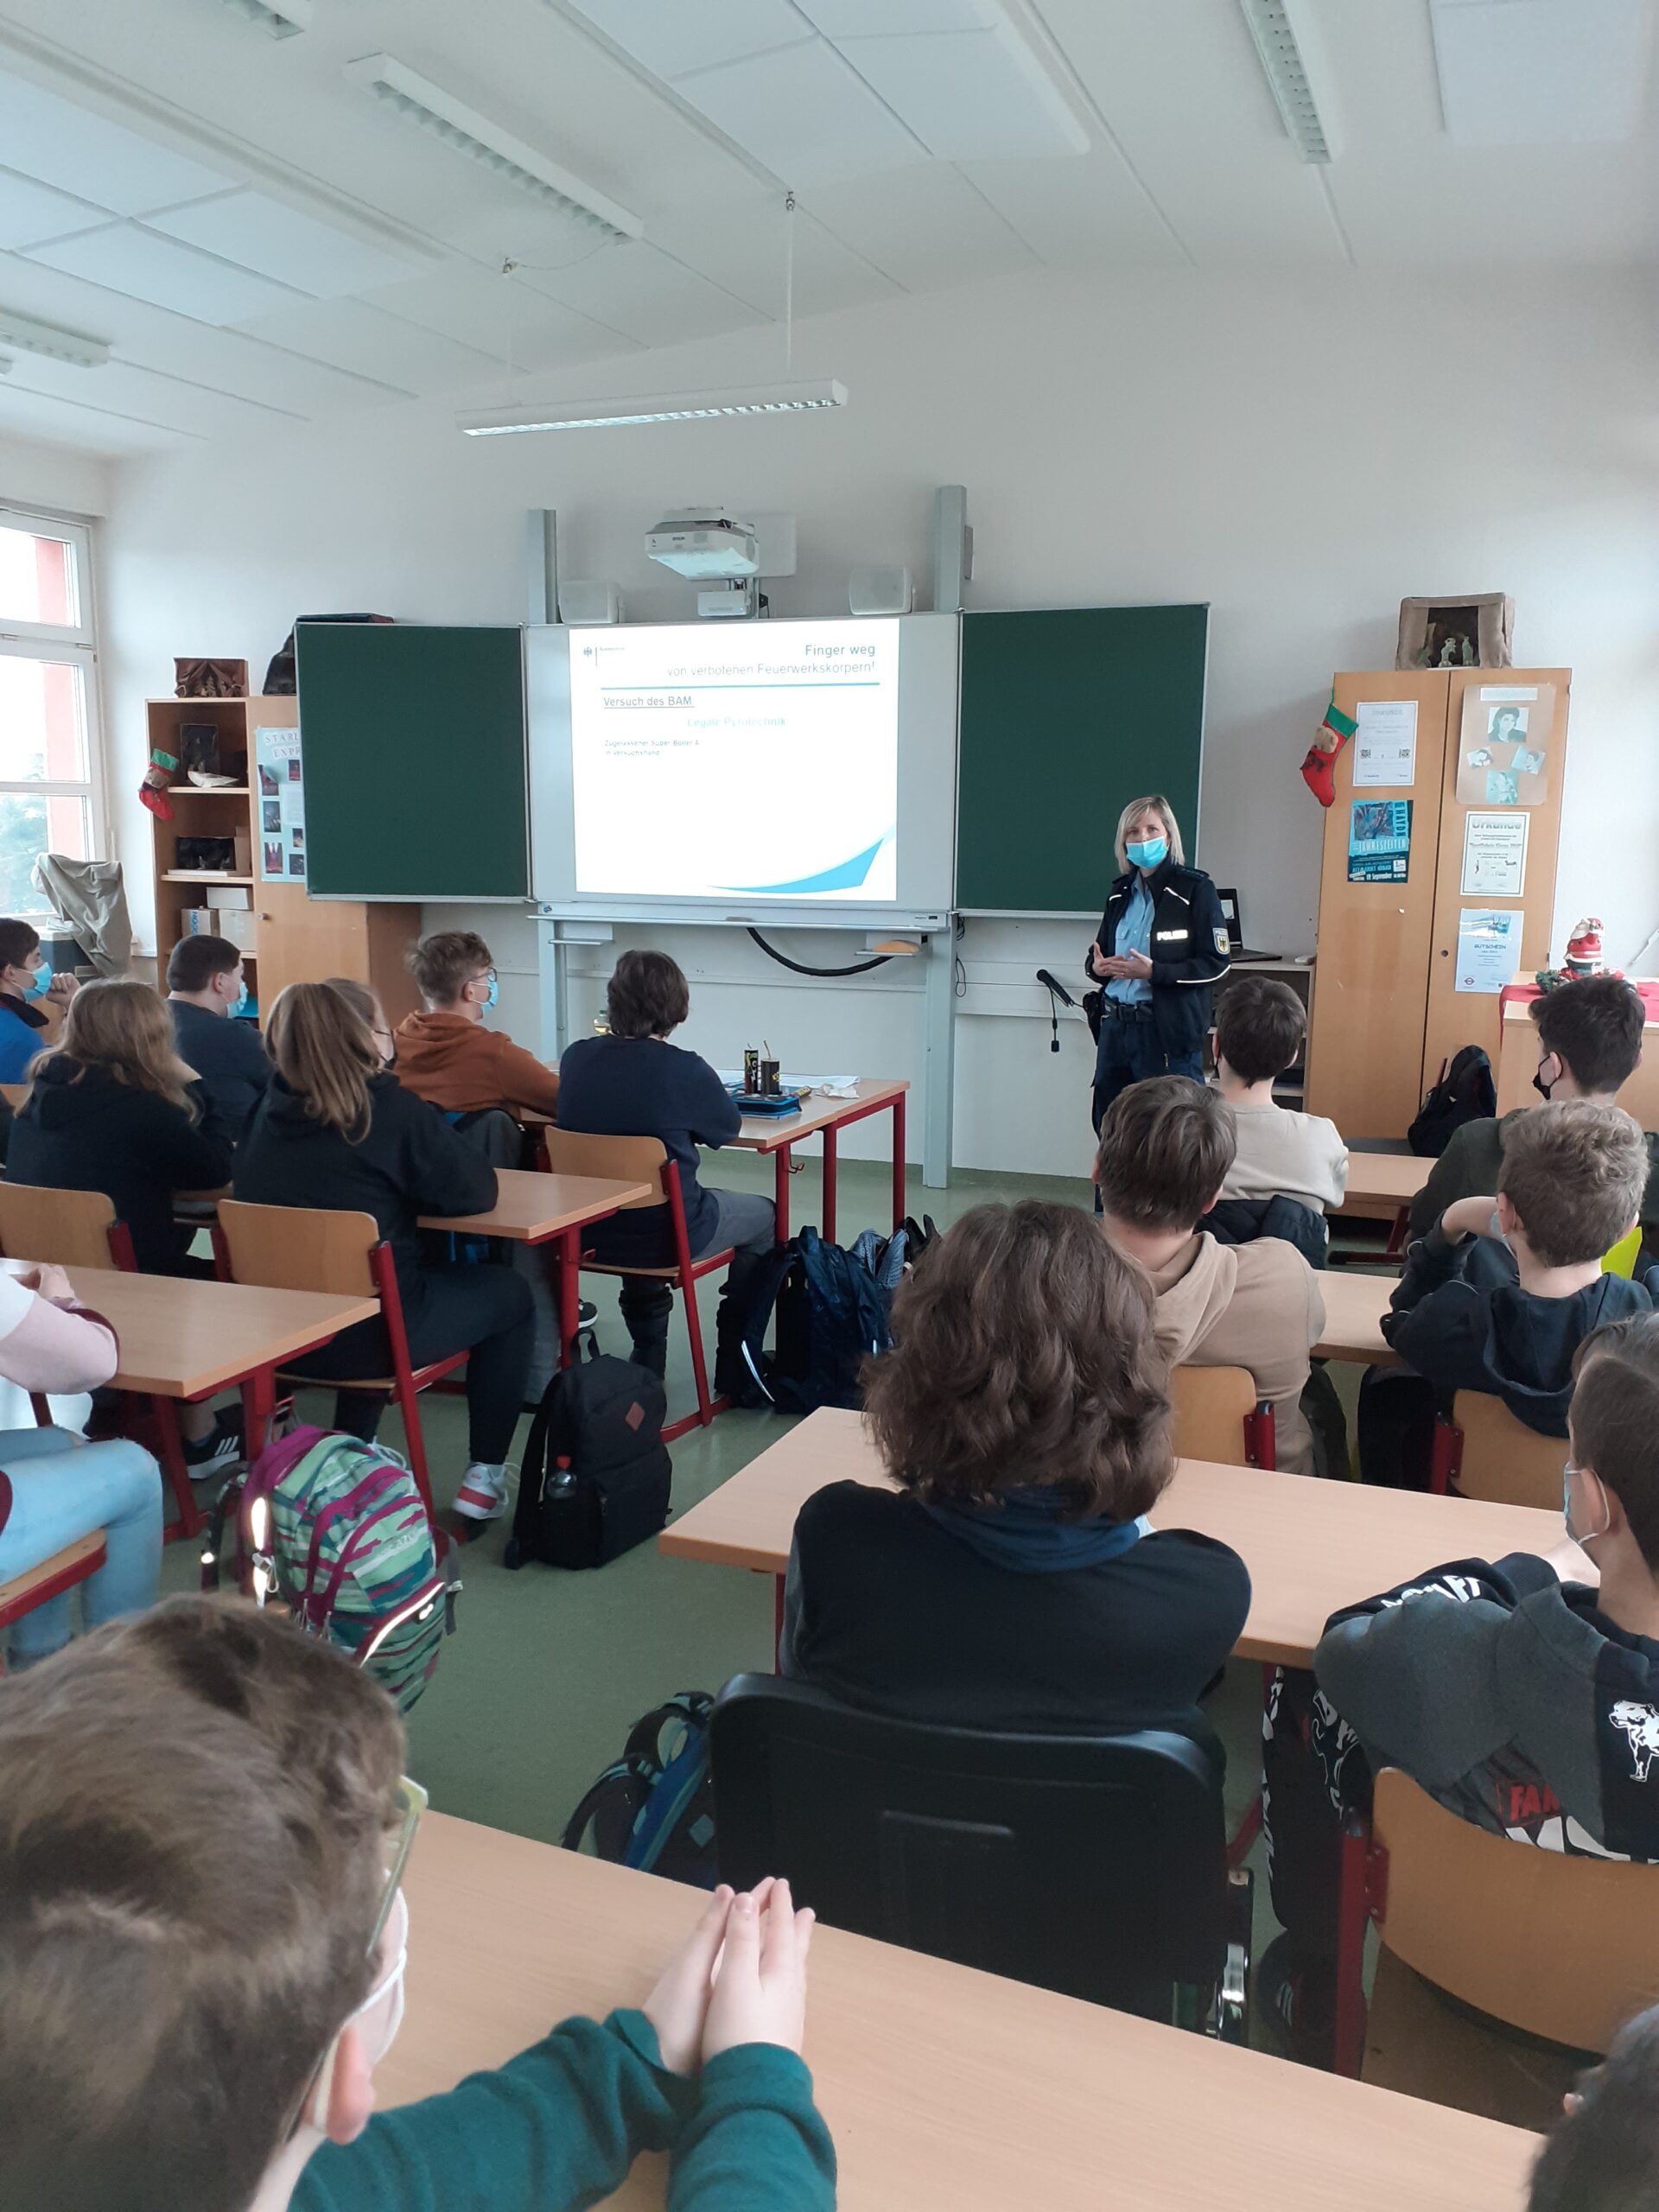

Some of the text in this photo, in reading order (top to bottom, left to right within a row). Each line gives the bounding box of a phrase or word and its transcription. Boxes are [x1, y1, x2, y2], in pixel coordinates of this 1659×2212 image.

[804, 645, 875, 658] Finger weg
[667, 667, 687, 677] von
[690, 664, 753, 677] verbotenen
[603, 696, 692, 707] Versuch des BAM
